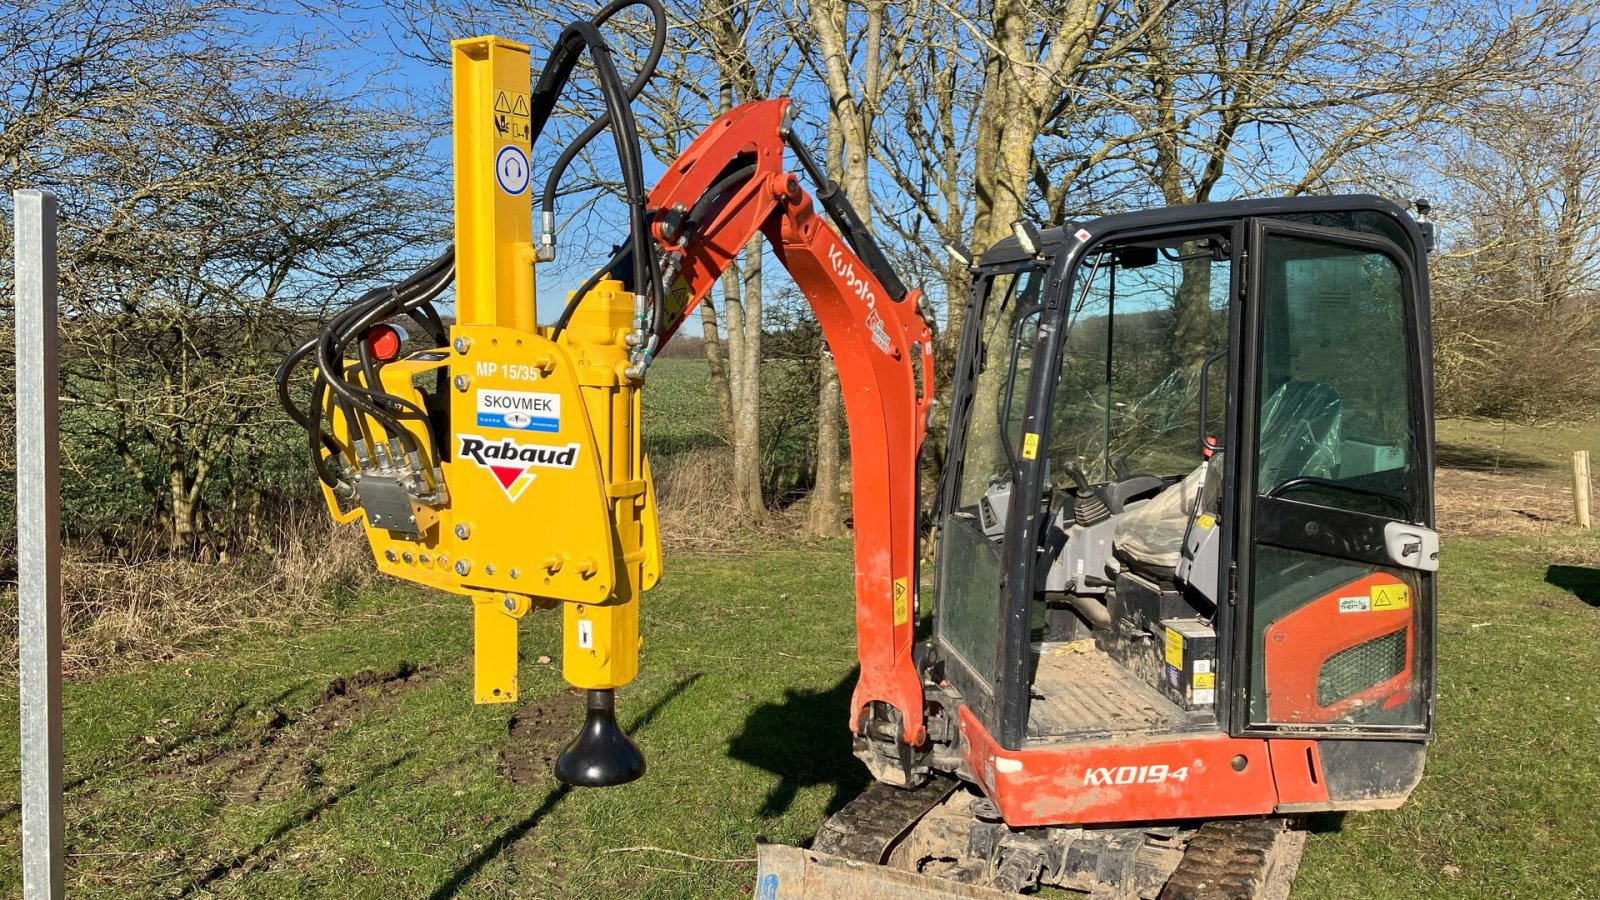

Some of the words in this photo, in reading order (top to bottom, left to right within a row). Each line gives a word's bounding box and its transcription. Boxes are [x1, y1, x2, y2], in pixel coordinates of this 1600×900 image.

[828, 243, 875, 309] Kubota
[476, 361, 497, 377] MP
[501, 364, 538, 381] 15/35
[484, 395, 552, 412] SKOVMEK
[461, 438, 576, 466] Rabaud
[1083, 765, 1188, 786] KX019-4
